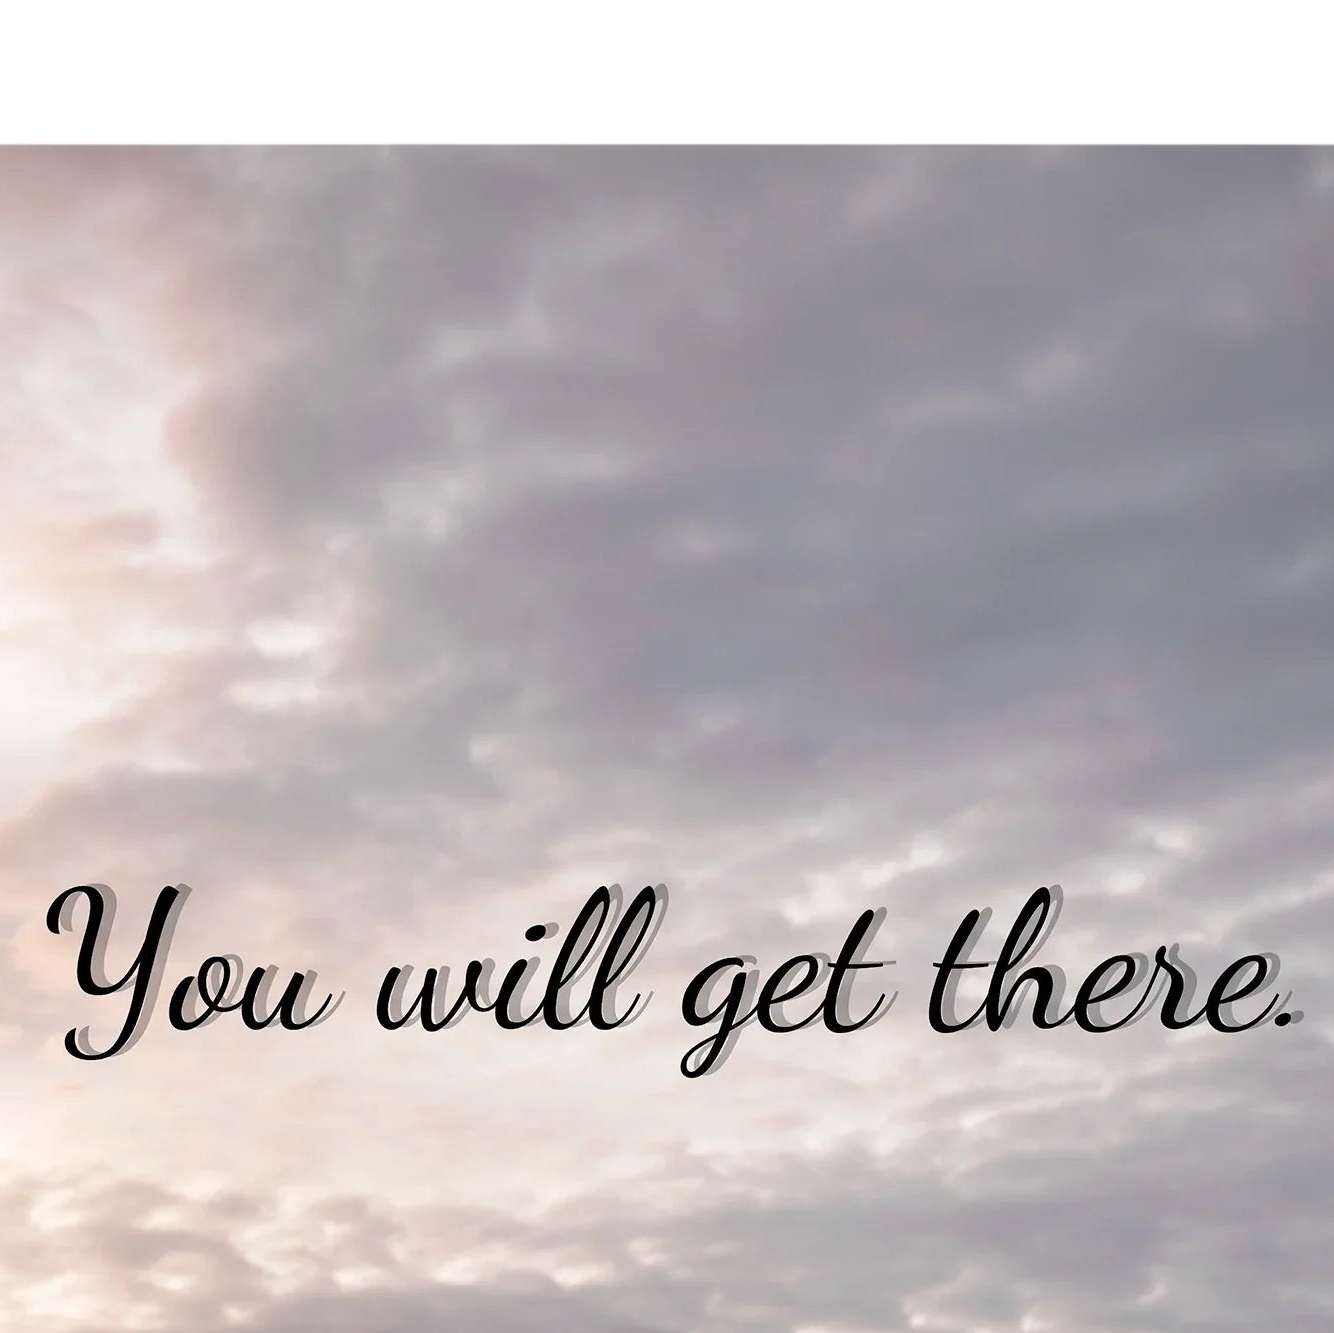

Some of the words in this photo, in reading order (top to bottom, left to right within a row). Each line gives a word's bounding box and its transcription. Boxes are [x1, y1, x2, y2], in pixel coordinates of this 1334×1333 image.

[46, 885, 334, 1061] You
[376, 885, 657, 1032] will
[680, 909, 887, 1079] get
[928, 886, 1293, 1034] there.
